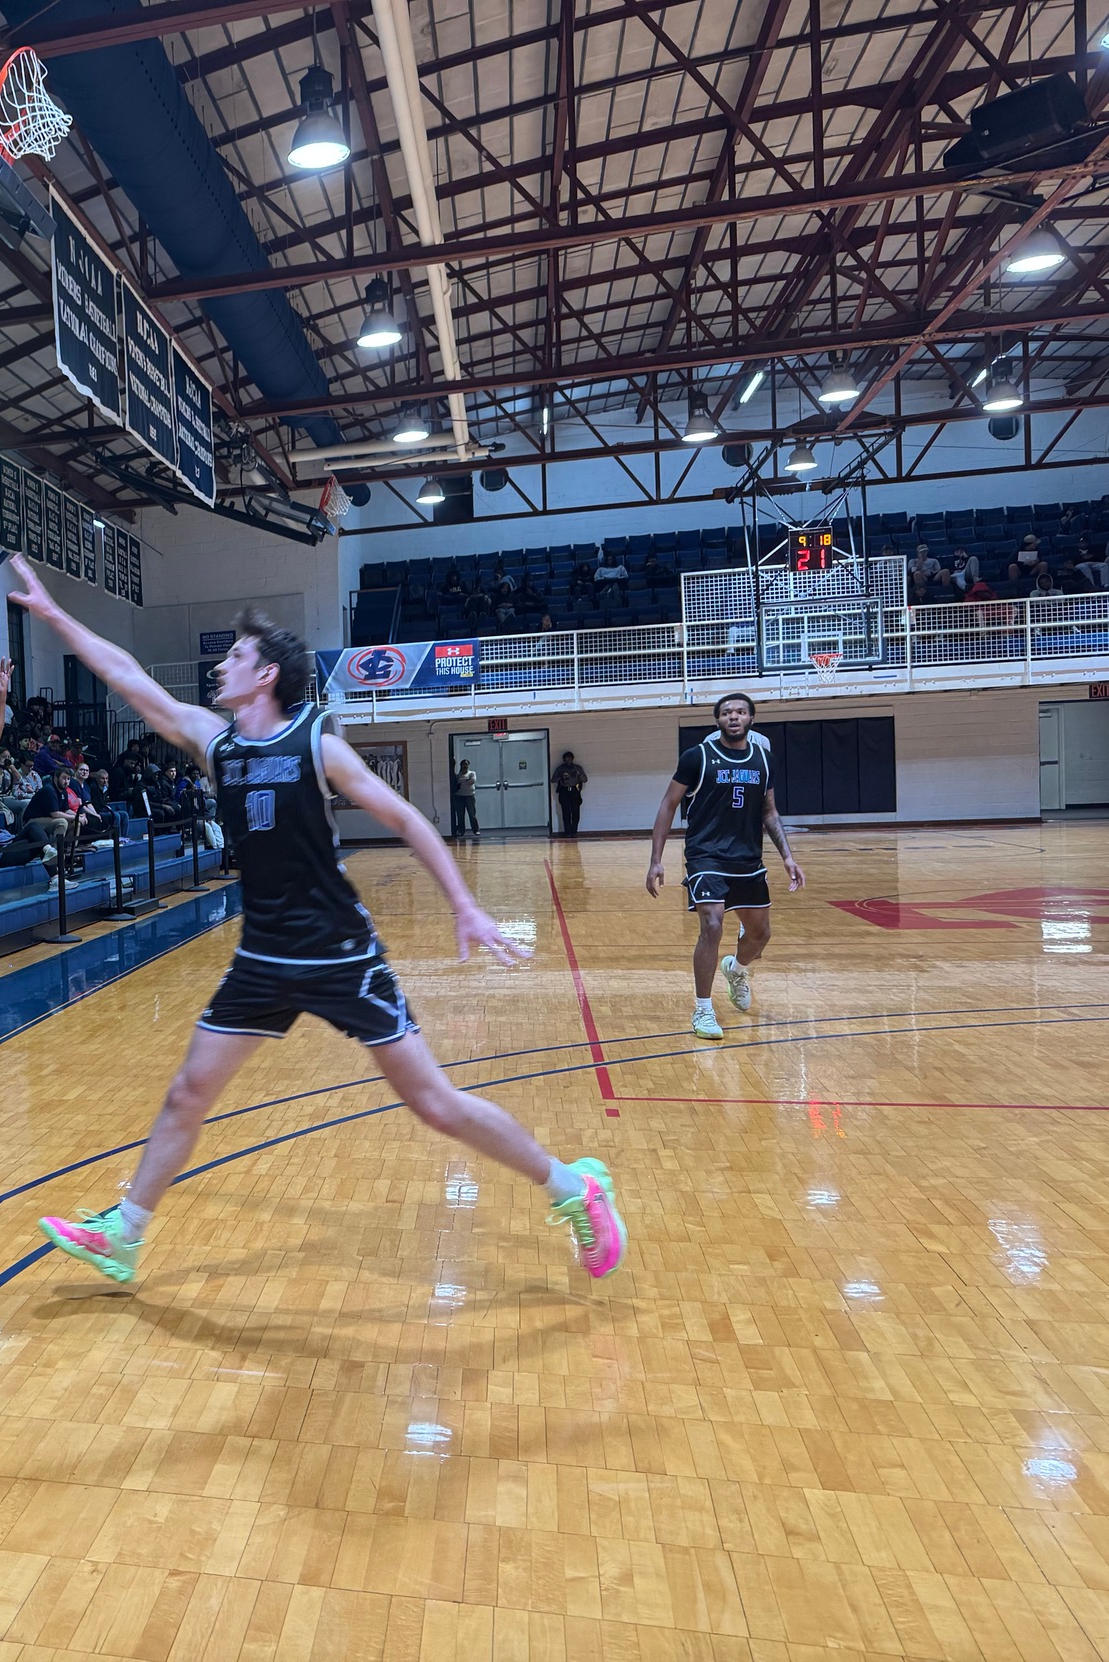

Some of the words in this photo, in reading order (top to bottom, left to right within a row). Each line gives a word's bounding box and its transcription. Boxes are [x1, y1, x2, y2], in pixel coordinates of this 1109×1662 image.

[797, 549, 825, 571] 21
[435, 656, 474, 668] PROTECT
[436, 668, 449, 676] THIS
[1092, 683, 1109, 697] EXIT
[490, 720, 505, 730] EXIT
[716, 769, 730, 784] JCC
[732, 786, 745, 808] 5
[245, 790, 276, 831] 10
